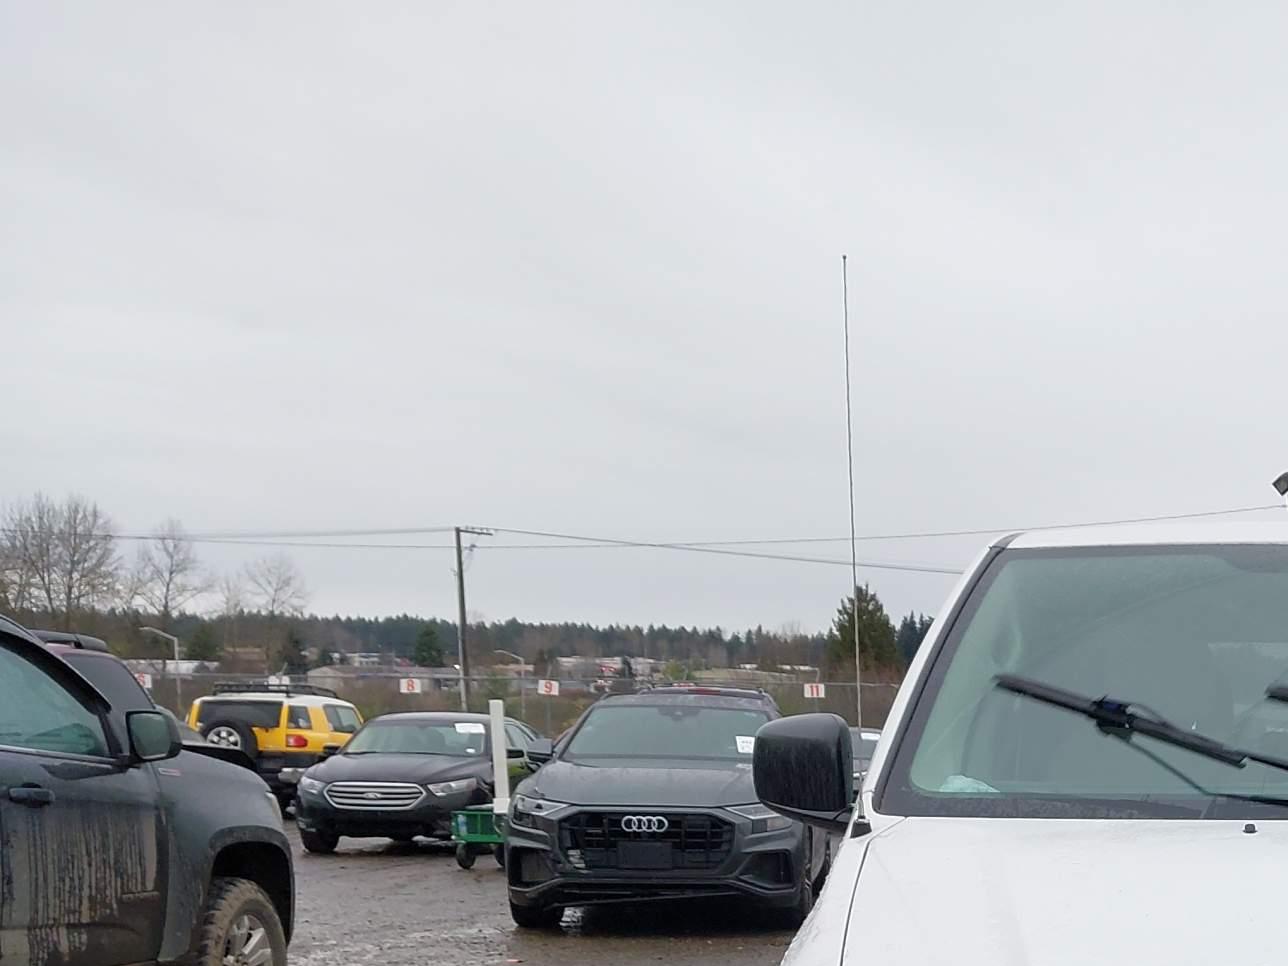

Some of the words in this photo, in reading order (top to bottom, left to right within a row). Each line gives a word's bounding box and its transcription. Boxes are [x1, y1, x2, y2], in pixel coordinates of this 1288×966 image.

[406, 678, 415, 692] 8
[543, 681, 553, 694] 9
[809, 684, 820, 697] 11
